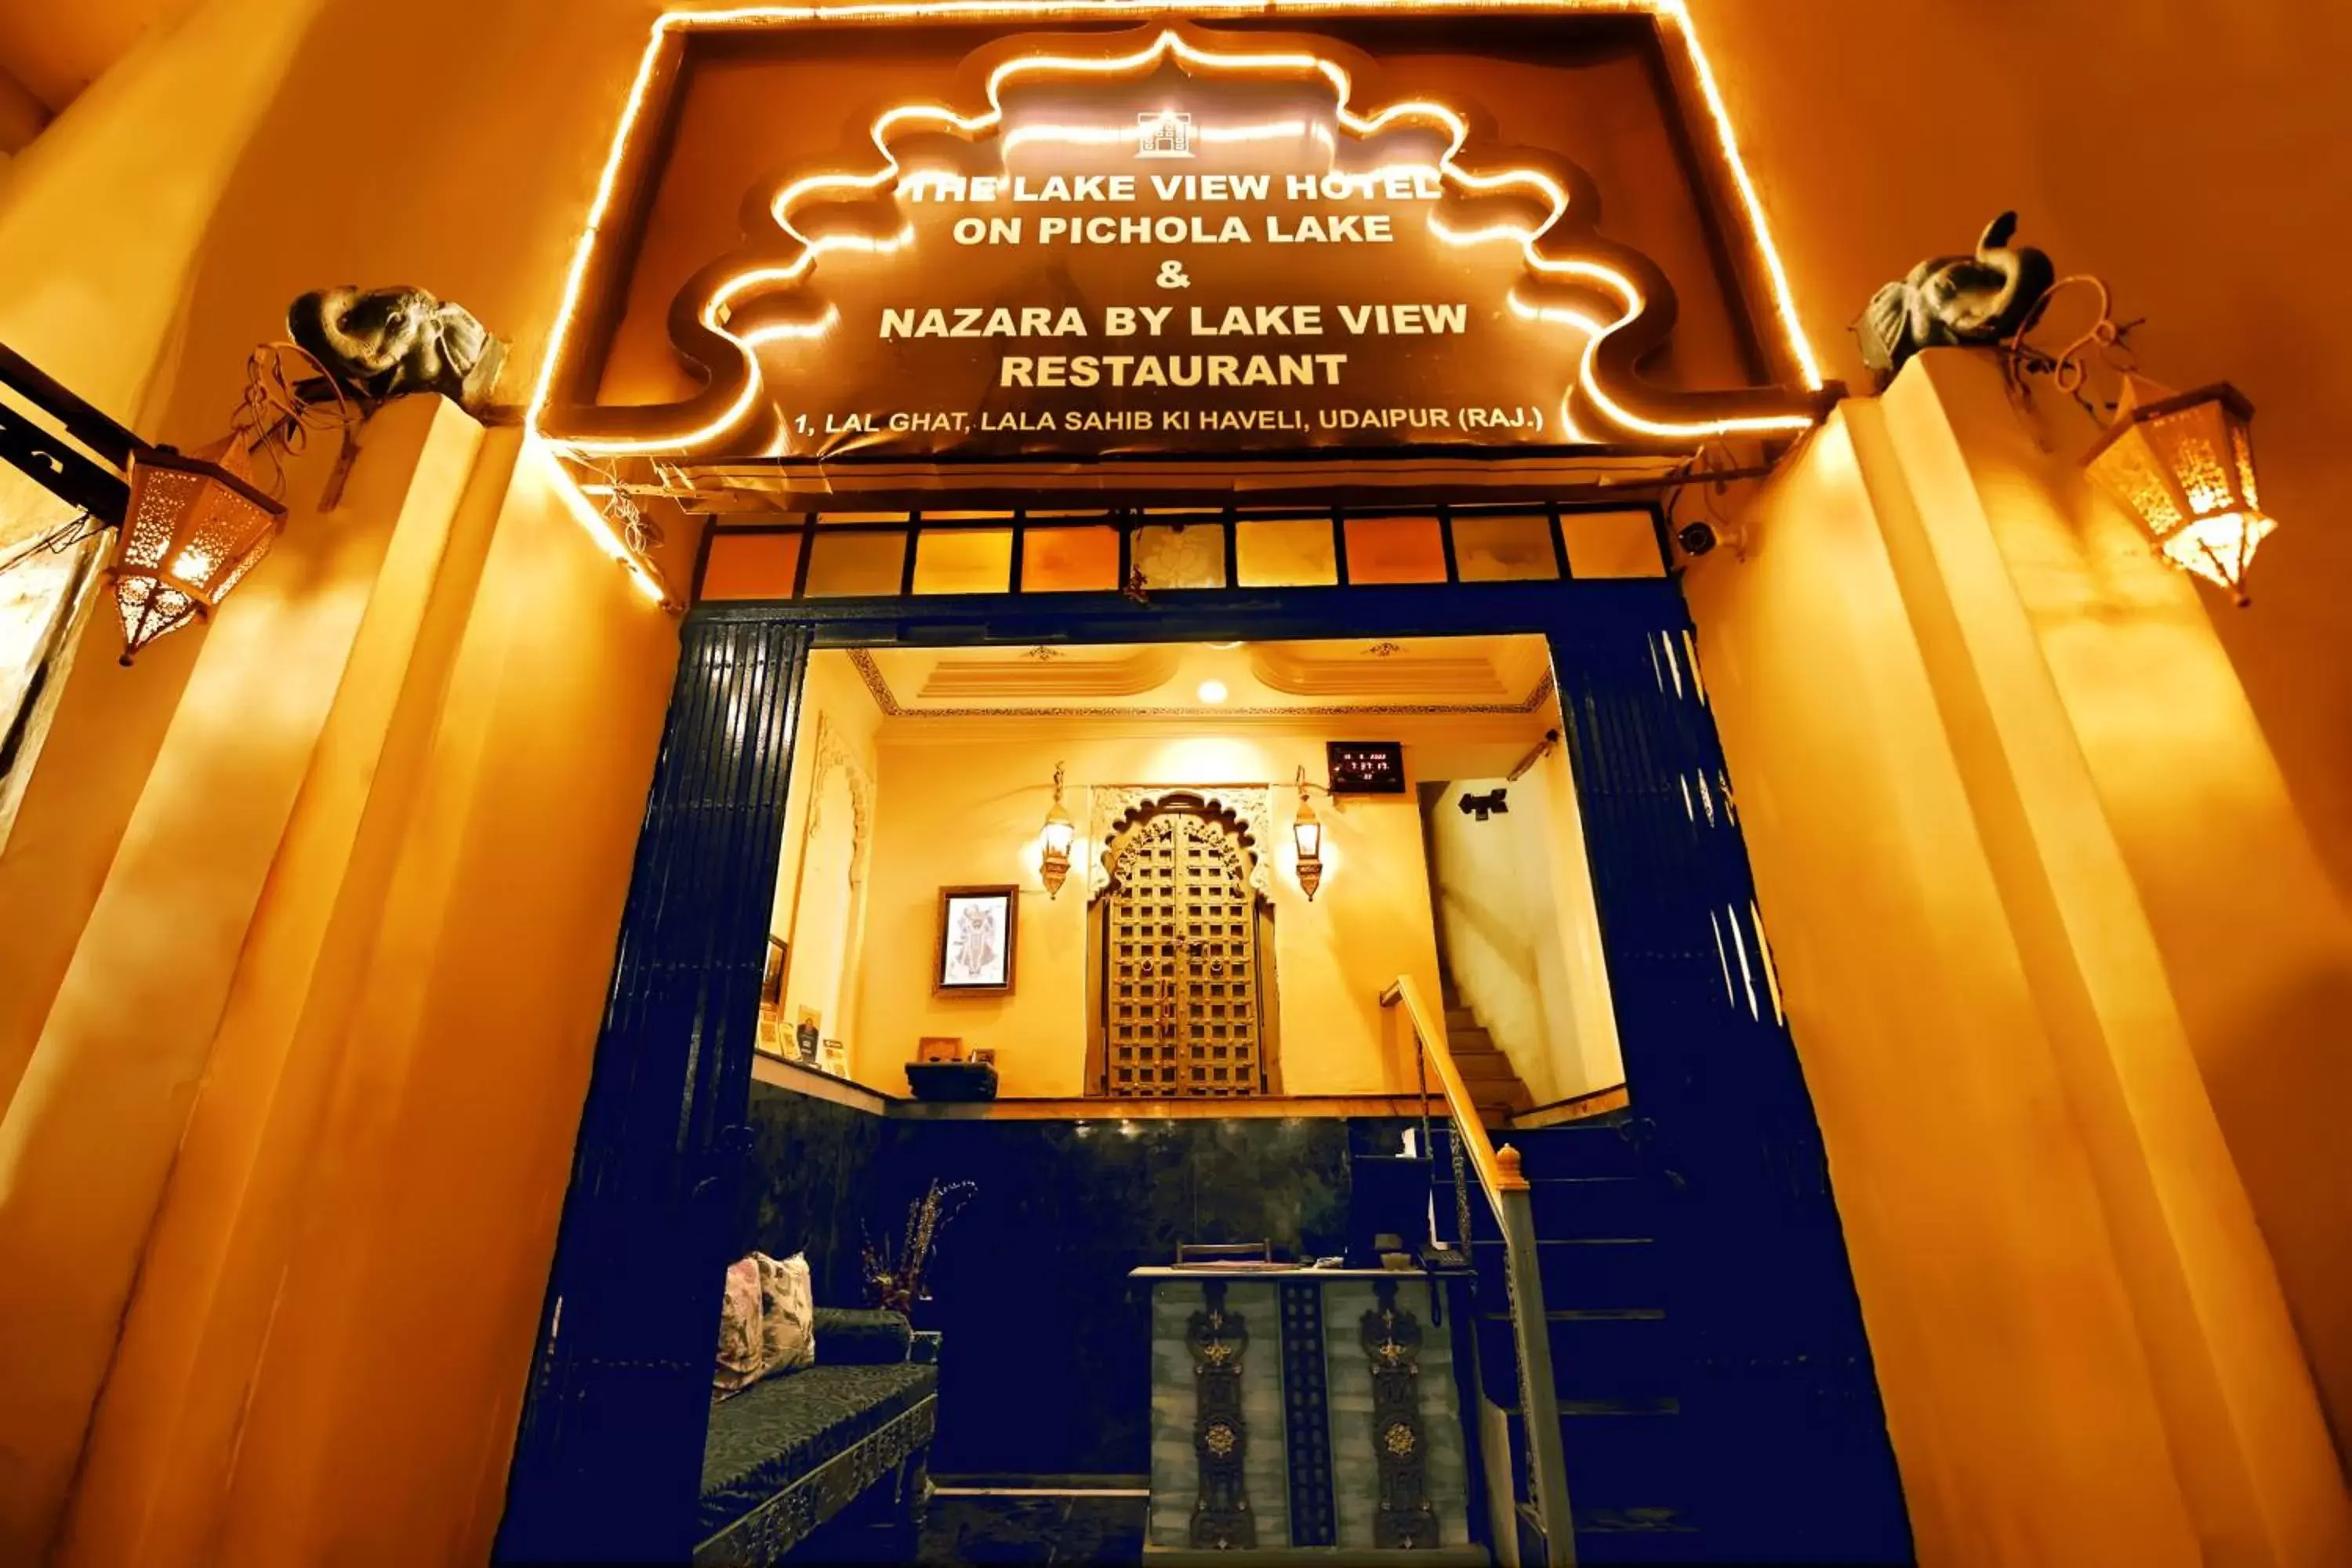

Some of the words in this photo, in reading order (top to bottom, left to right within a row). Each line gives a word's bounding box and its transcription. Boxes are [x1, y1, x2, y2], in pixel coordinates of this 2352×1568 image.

[908, 175, 997, 201] THE
[1013, 175, 1136, 201] LAKE
[1150, 174, 1271, 201] VIEW
[1285, 174, 1443, 201] HOTEL
[953, 216, 1022, 245] ON
[1039, 216, 1252, 245] PICHOLA
[1266, 215, 1394, 243] LAKE
[1156, 260, 1191, 289] &
[879, 307, 1088, 338] NAZARA
[1105, 306, 1174, 337] BY
[1189, 305, 1323, 336] LAKE
[1337, 303, 1468, 335] VIEW
[1000, 354, 1348, 387] RESTAURANT
[793, 413, 815, 437] 1,
[825, 412, 880, 434] LAL
[888, 412, 971, 434] GHAT,
[981, 411, 1057, 431] LALA
[1064, 410, 1153, 431] SAHIB
[1163, 410, 1189, 430] KI
[1200, 409, 1310, 432] HAVELI,
[1319, 408, 1451, 429] UDAIPUR
[1457, 406, 1544, 433] (RAJ.)
